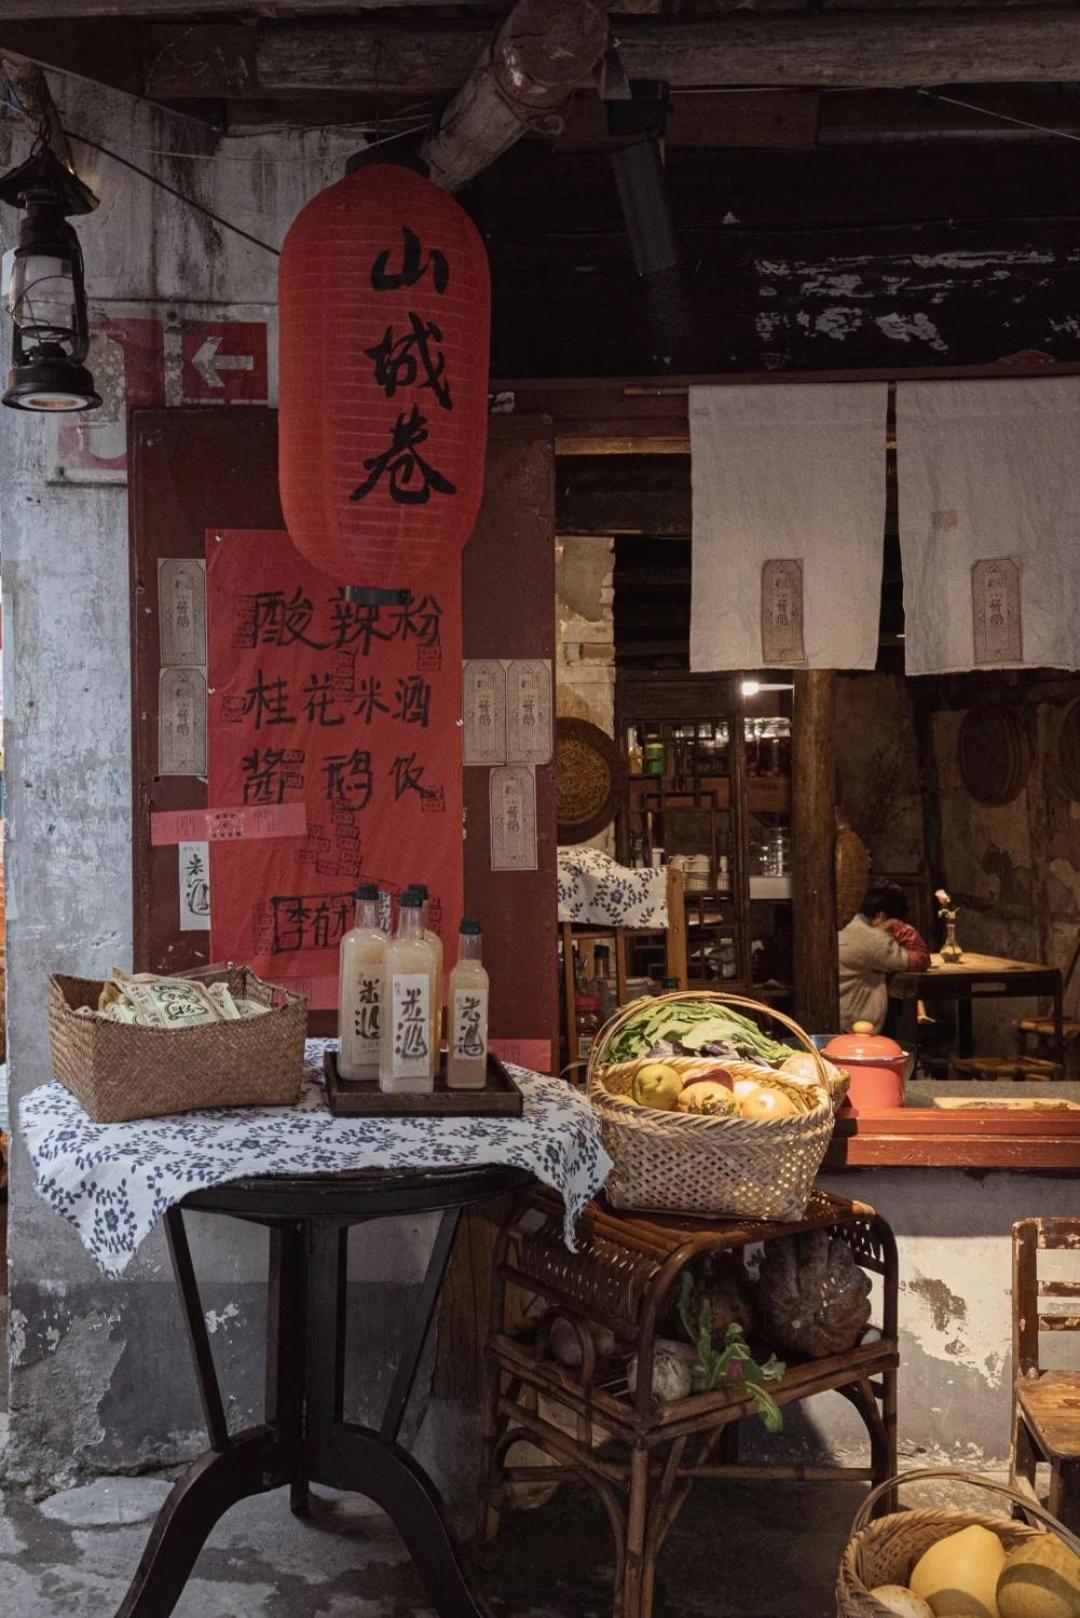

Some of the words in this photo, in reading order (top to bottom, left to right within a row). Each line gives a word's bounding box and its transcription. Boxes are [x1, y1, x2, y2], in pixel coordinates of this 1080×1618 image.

[251, 585, 443, 655] 酸辣粉
[245, 668, 433, 730] 桂花米酒
